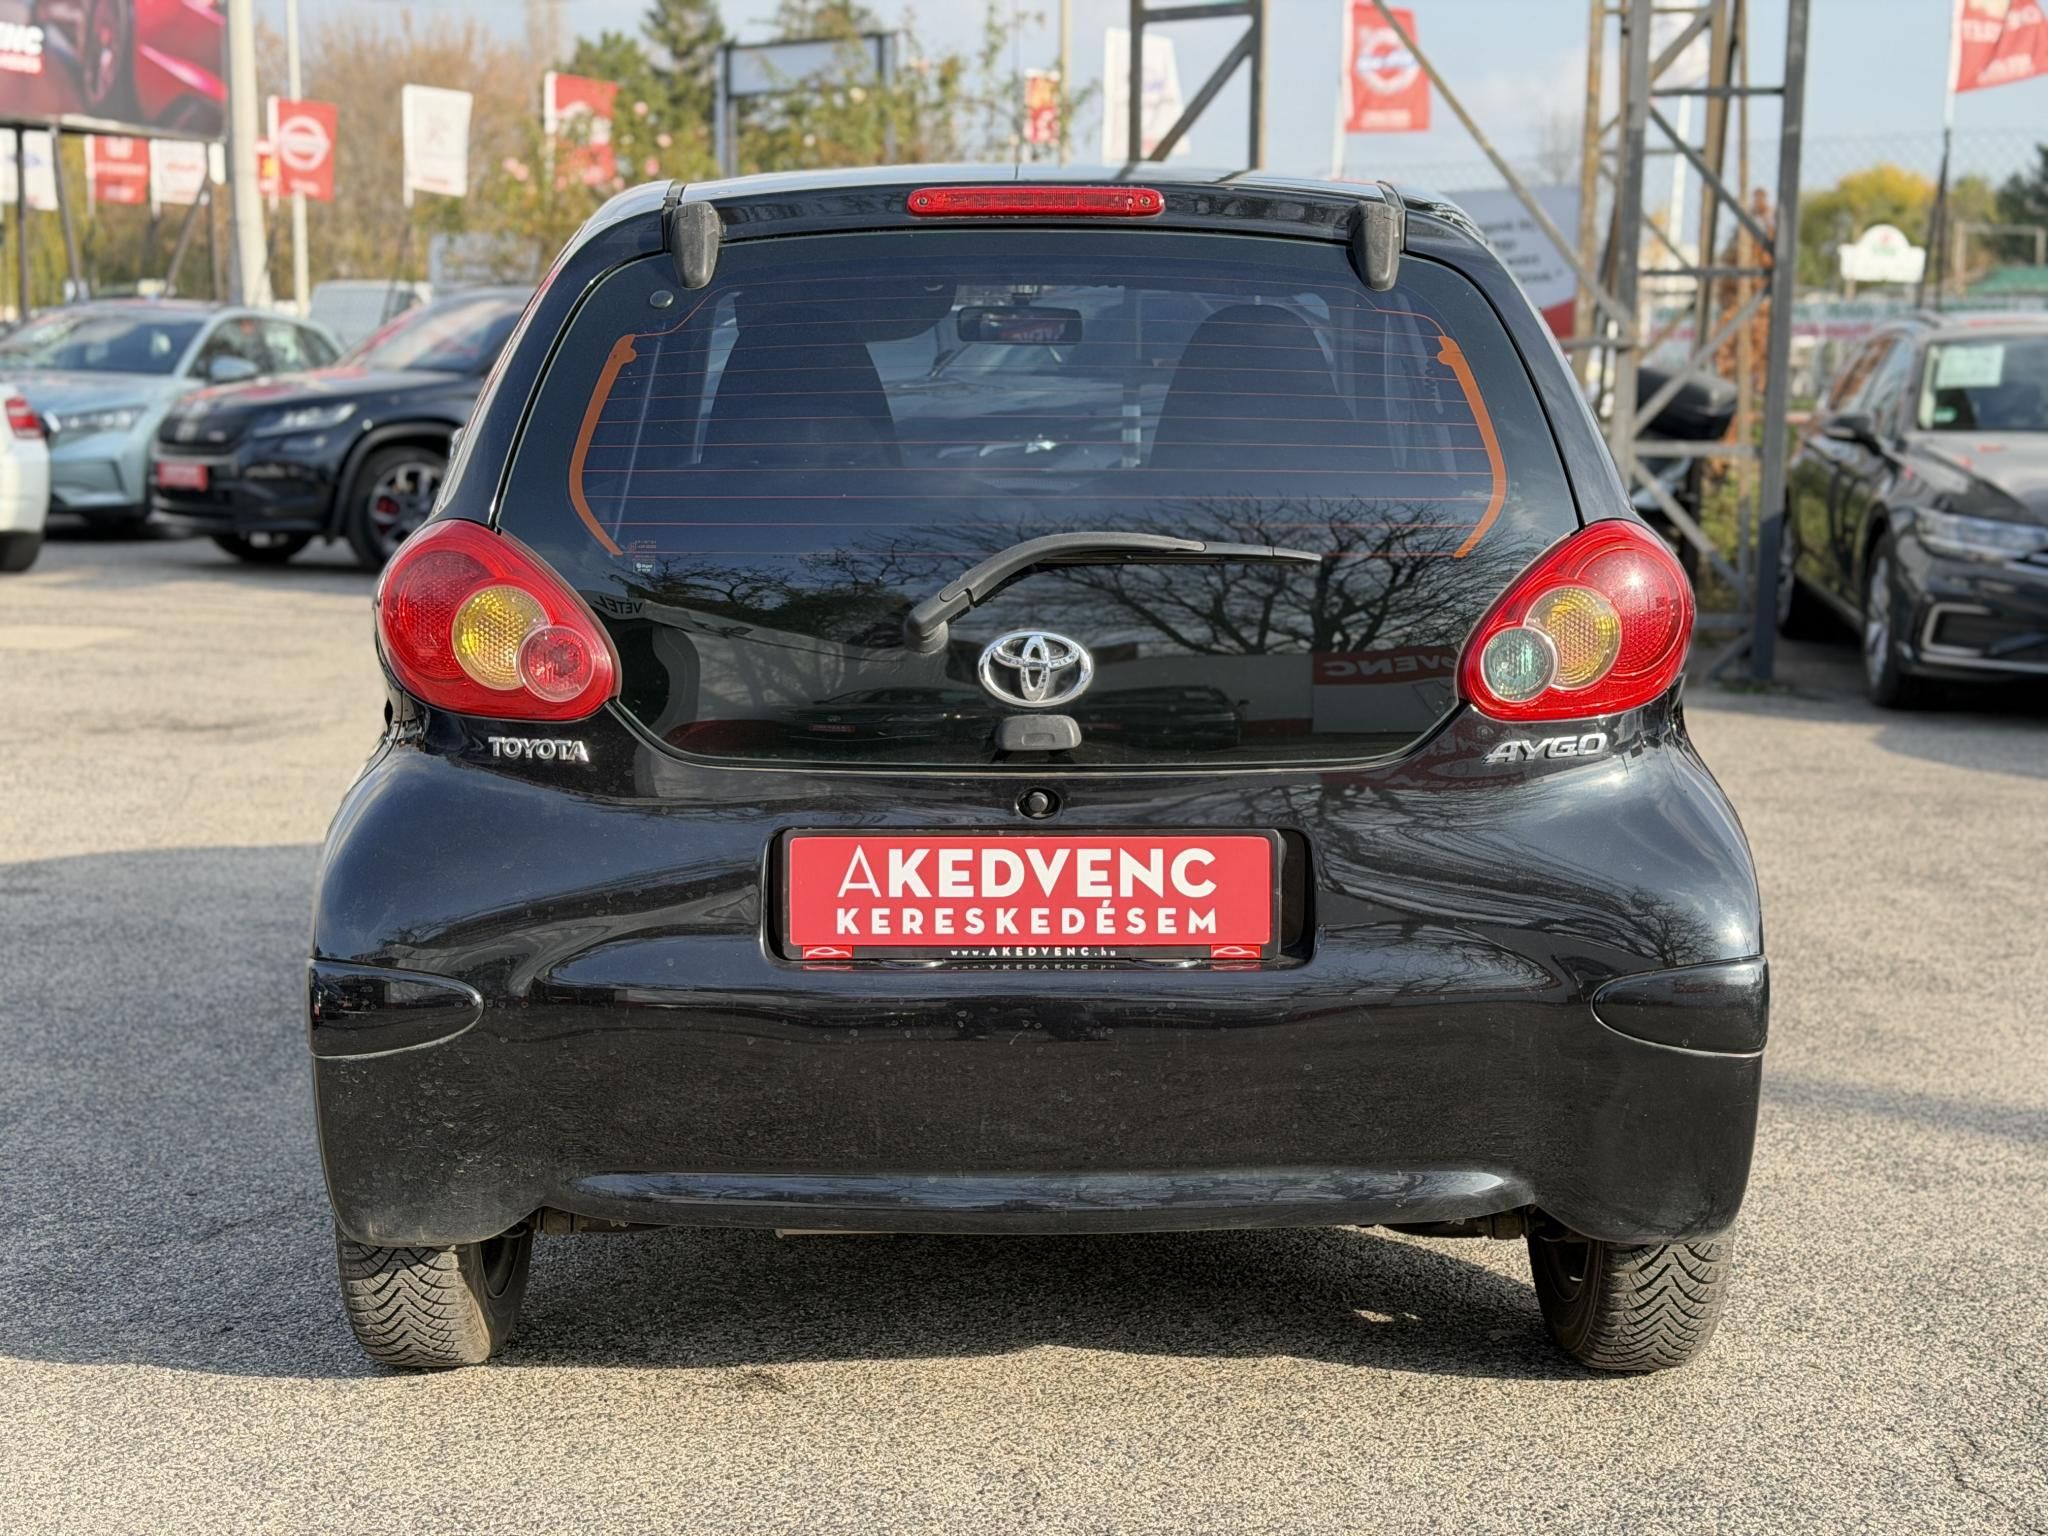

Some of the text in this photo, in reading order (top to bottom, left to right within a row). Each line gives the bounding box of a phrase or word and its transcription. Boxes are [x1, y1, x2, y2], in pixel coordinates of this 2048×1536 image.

[488, 736, 590, 762] TOYOTA
[1481, 732, 1608, 764] AYGO
[837, 844, 1217, 898] AKEDVENC
[836, 900, 1217, 936] KERESKEDÉSEM
[951, 946, 1116, 957] www.AKEDVENC.hu
